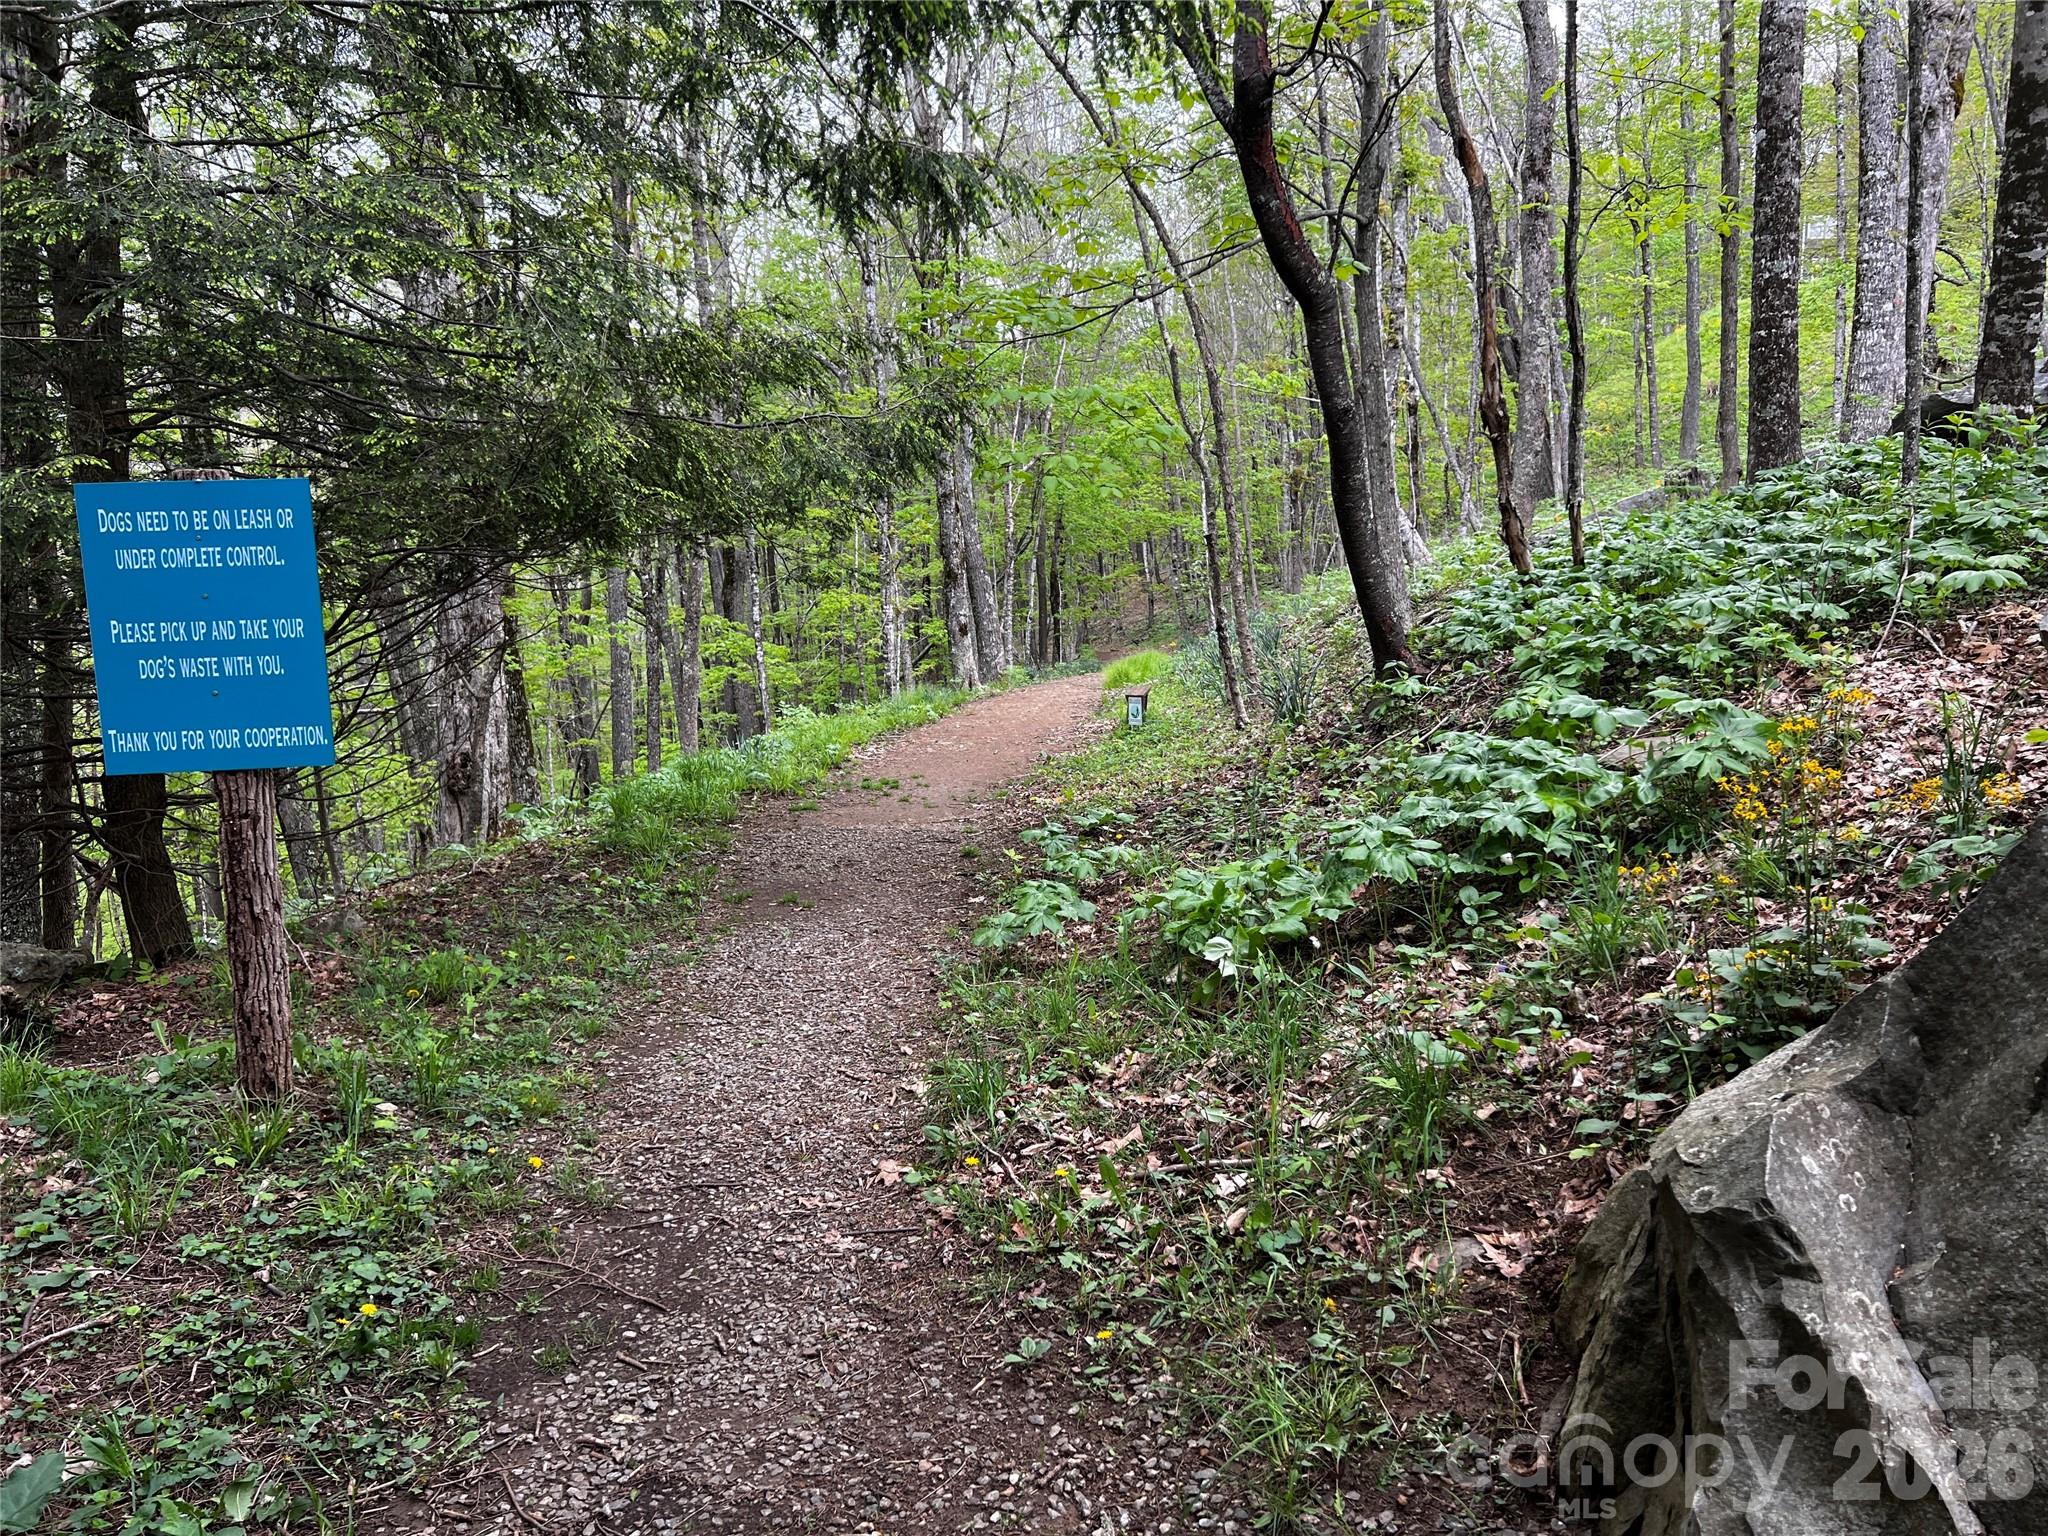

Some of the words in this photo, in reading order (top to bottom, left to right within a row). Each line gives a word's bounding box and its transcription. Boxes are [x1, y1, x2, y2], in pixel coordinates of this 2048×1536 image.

[98, 509, 132, 532] DOGS
[137, 511, 168, 531] NEED
[172, 511, 188, 530] TO
[193, 511, 209, 530] BE
[213, 510, 230, 529] ON
[235, 509, 272, 529] LEASH
[277, 509, 293, 528] OR
[115, 549, 156, 569] UNDER
[161, 547, 222, 568] COMPLETE
[227, 546, 284, 566] CONTROL.
[111, 620, 156, 643] PLEASE
[160, 622, 187, 641] PICK
[191, 621, 206, 641] UP
[213, 621, 235, 640] AND
[239, 619, 268, 639] TAKE
[273, 619, 304, 638] YOUR
[139, 656, 175, 679] DOG'S
[179, 657, 219, 677] WASTE
[223, 657, 253, 676] WITH
[257, 656, 284, 675] YOU.
[108, 730, 150, 752] THANK
[153, 732, 177, 750] YOU
[182, 731, 204, 749] FOR
[209, 729, 240, 748] YOUR
[245, 726, 327, 747] COOPERATION.
